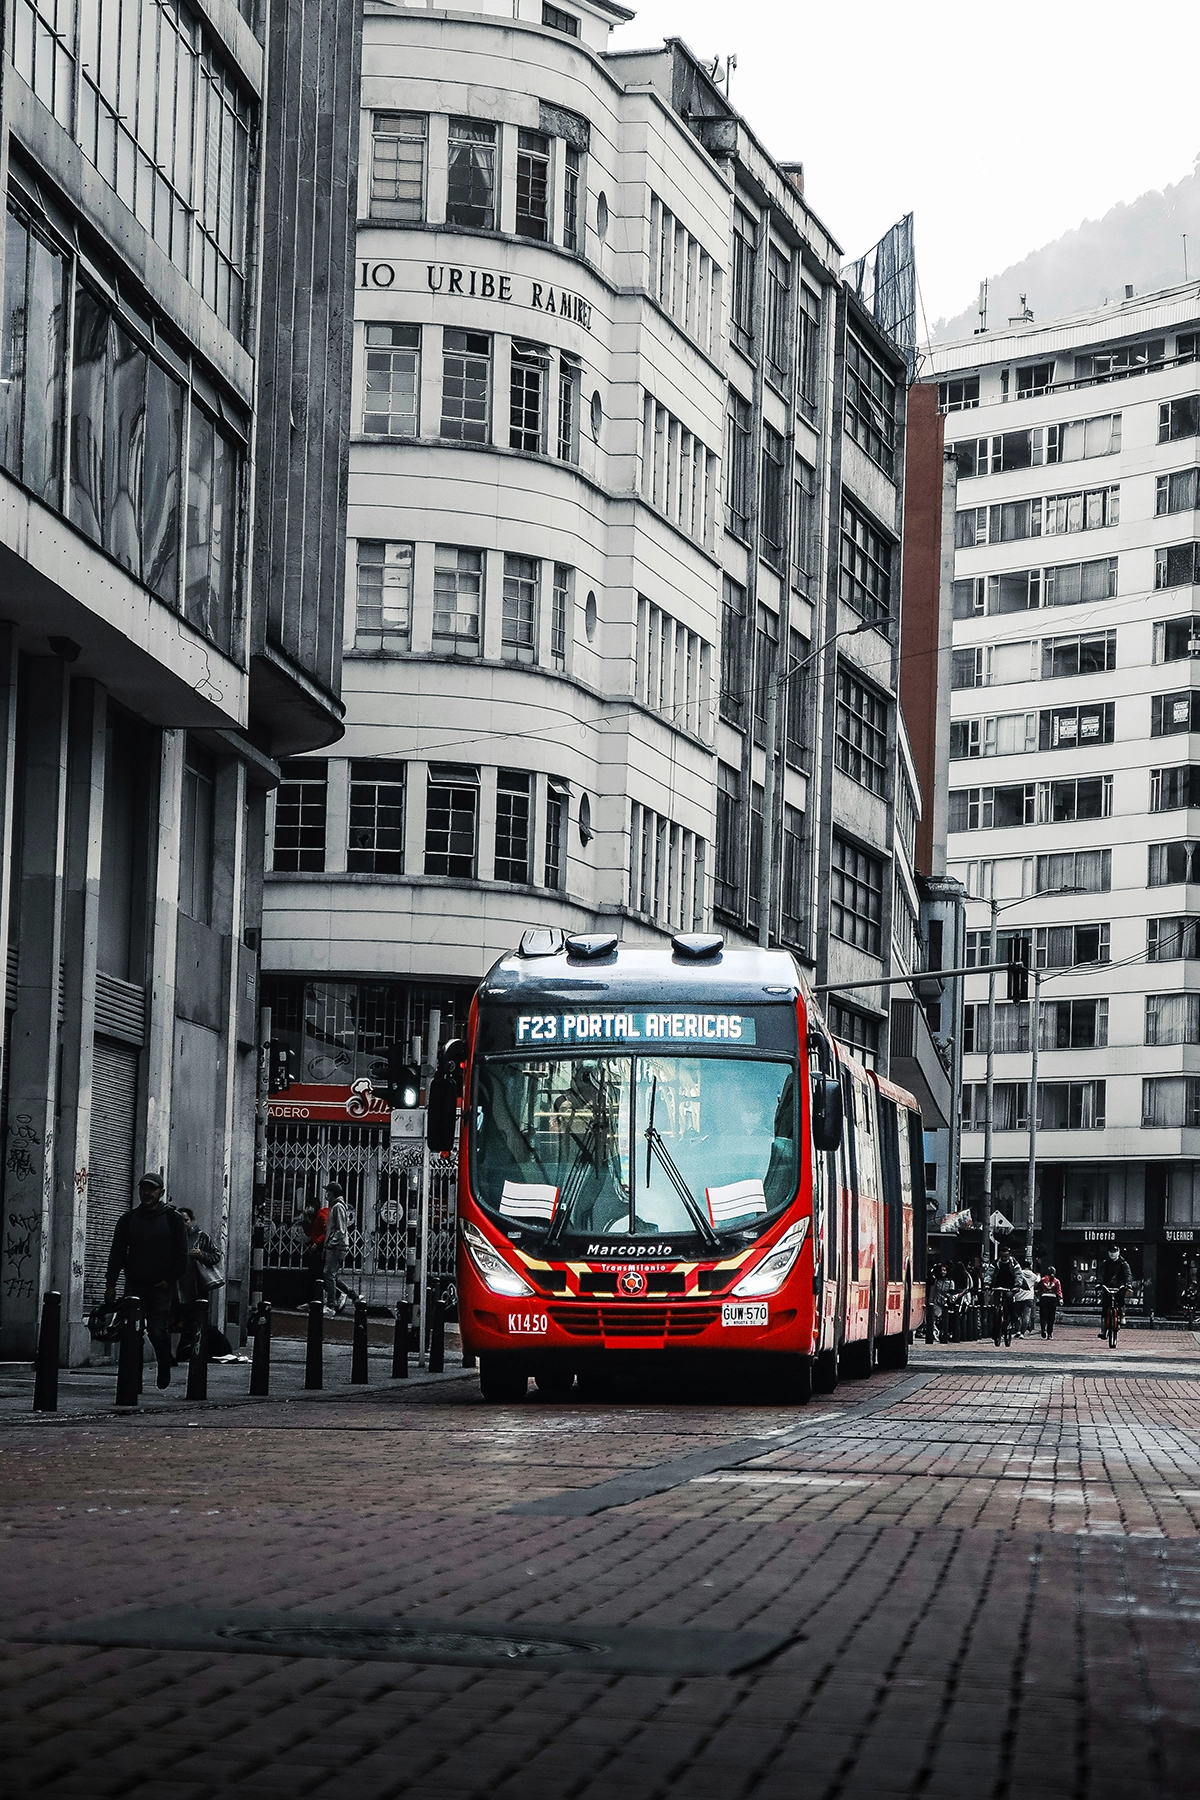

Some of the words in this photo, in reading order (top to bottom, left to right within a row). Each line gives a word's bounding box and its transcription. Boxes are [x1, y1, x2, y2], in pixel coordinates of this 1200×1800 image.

[427, 265, 513, 300] URIBE
[531, 281, 593, 331] RAMIREZ
[518, 1015, 557, 1039] F23
[563, 1014, 641, 1038] PORTAL
[645, 1014, 743, 1039] AMERICAS
[1173, 1231, 1194, 1241] LERNER
[586, 1244, 673, 1257] Marcopolo
[601, 1263, 666, 1272] TransMilenio
[508, 1313, 548, 1332] K1450
